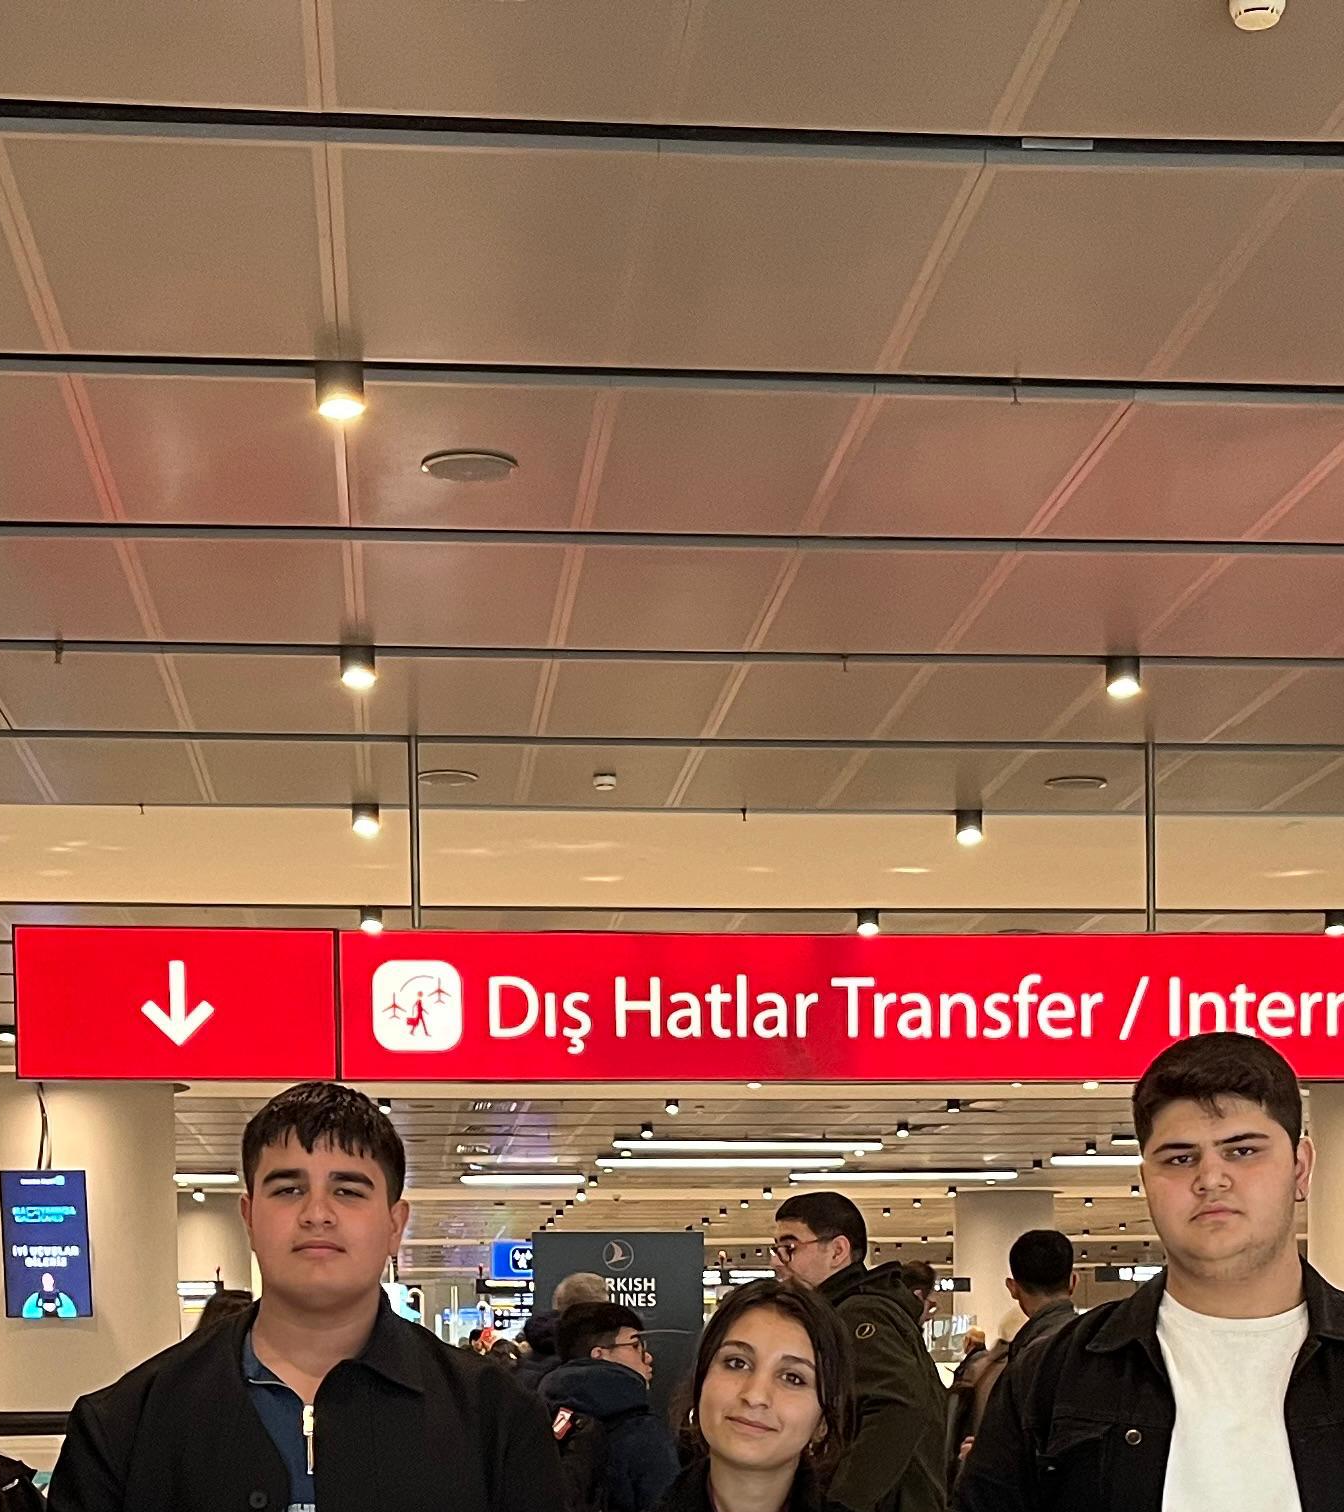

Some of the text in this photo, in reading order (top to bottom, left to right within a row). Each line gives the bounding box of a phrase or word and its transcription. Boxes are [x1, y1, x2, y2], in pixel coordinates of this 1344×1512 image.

[489, 975, 593, 1053] Dış
[615, 974, 819, 1039] Hatlar
[831, 974, 1104, 1039] Transfer
[1119, 976, 1151, 1041] /
[605, 1277, 655, 1292] RKISH
[611, 1293, 656, 1307] LINES
